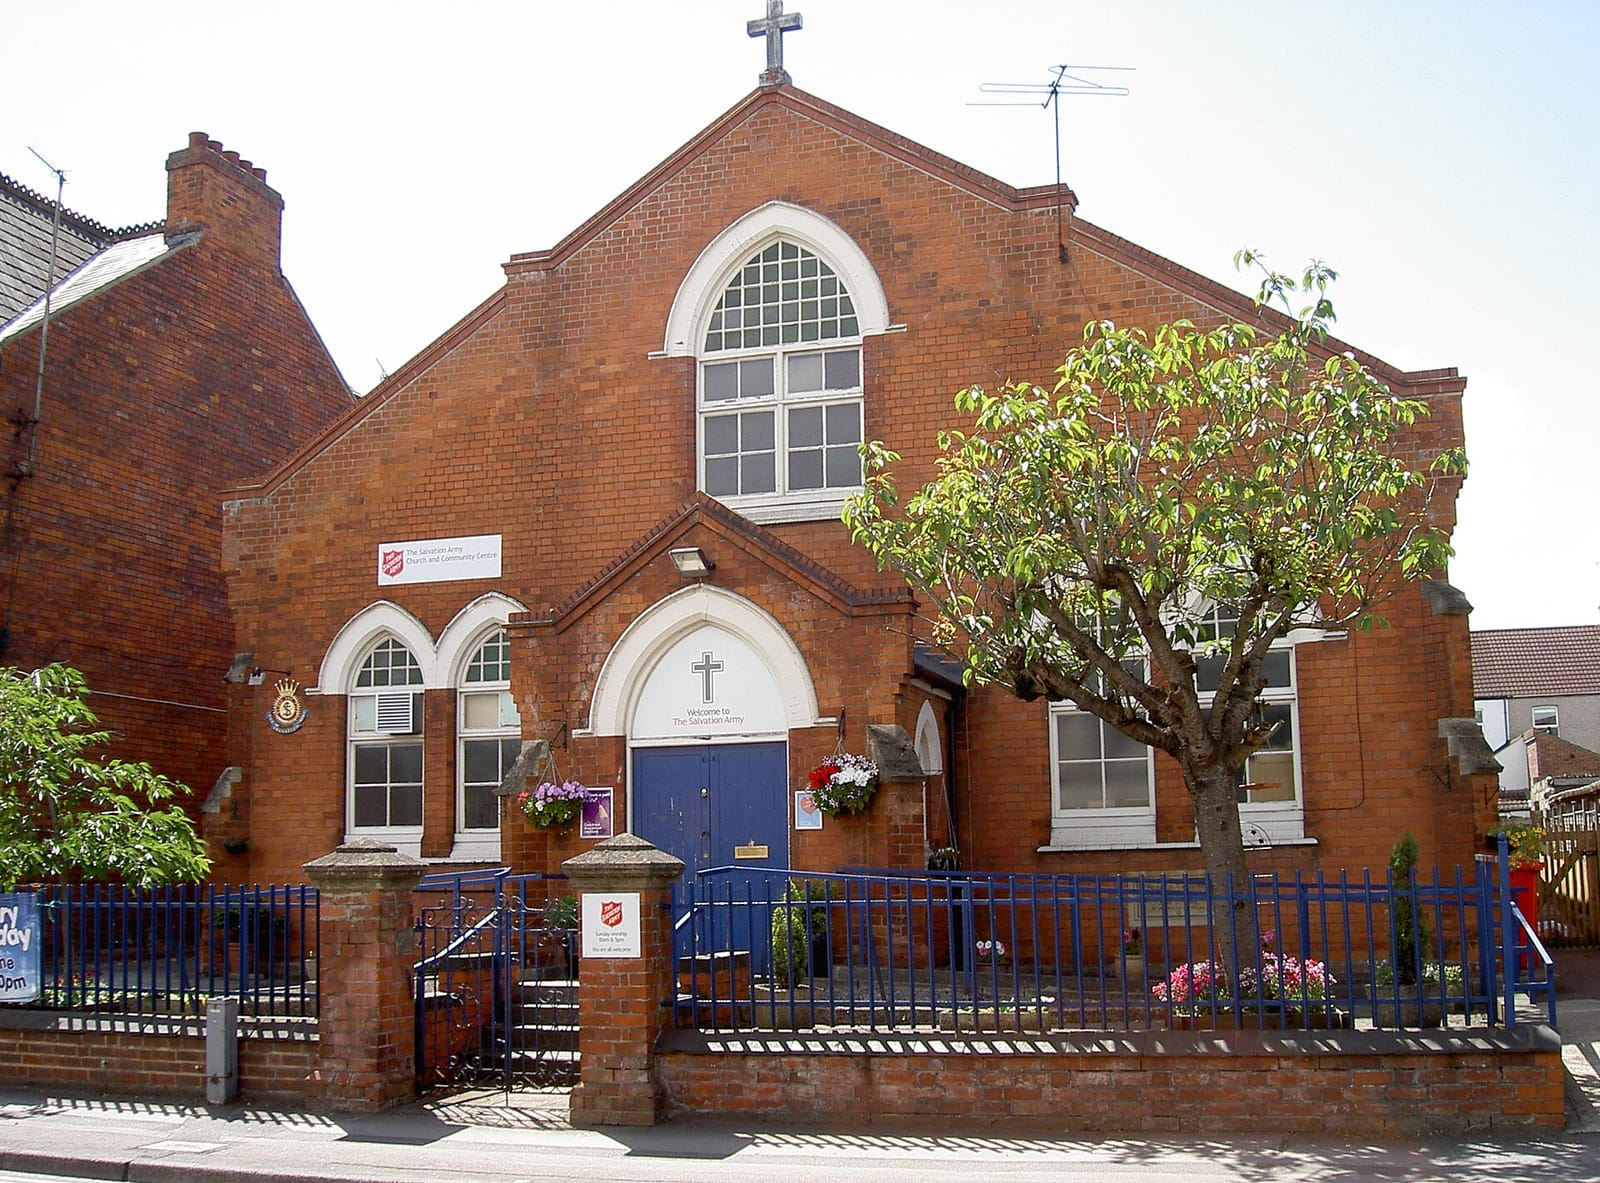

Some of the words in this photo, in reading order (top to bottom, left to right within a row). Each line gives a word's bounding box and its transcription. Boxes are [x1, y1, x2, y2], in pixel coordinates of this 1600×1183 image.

[419, 547, 446, 556] Salvation
[447, 546, 464, 554] Army
[441, 554, 475, 562] Community
[476, 552, 498, 560] Centre
[686, 708, 721, 717] Welcome
[721, 707, 731, 715] to
[673, 718, 688, 726] The
[688, 716, 723, 726] Salvation
[724, 715, 745, 725] Army
